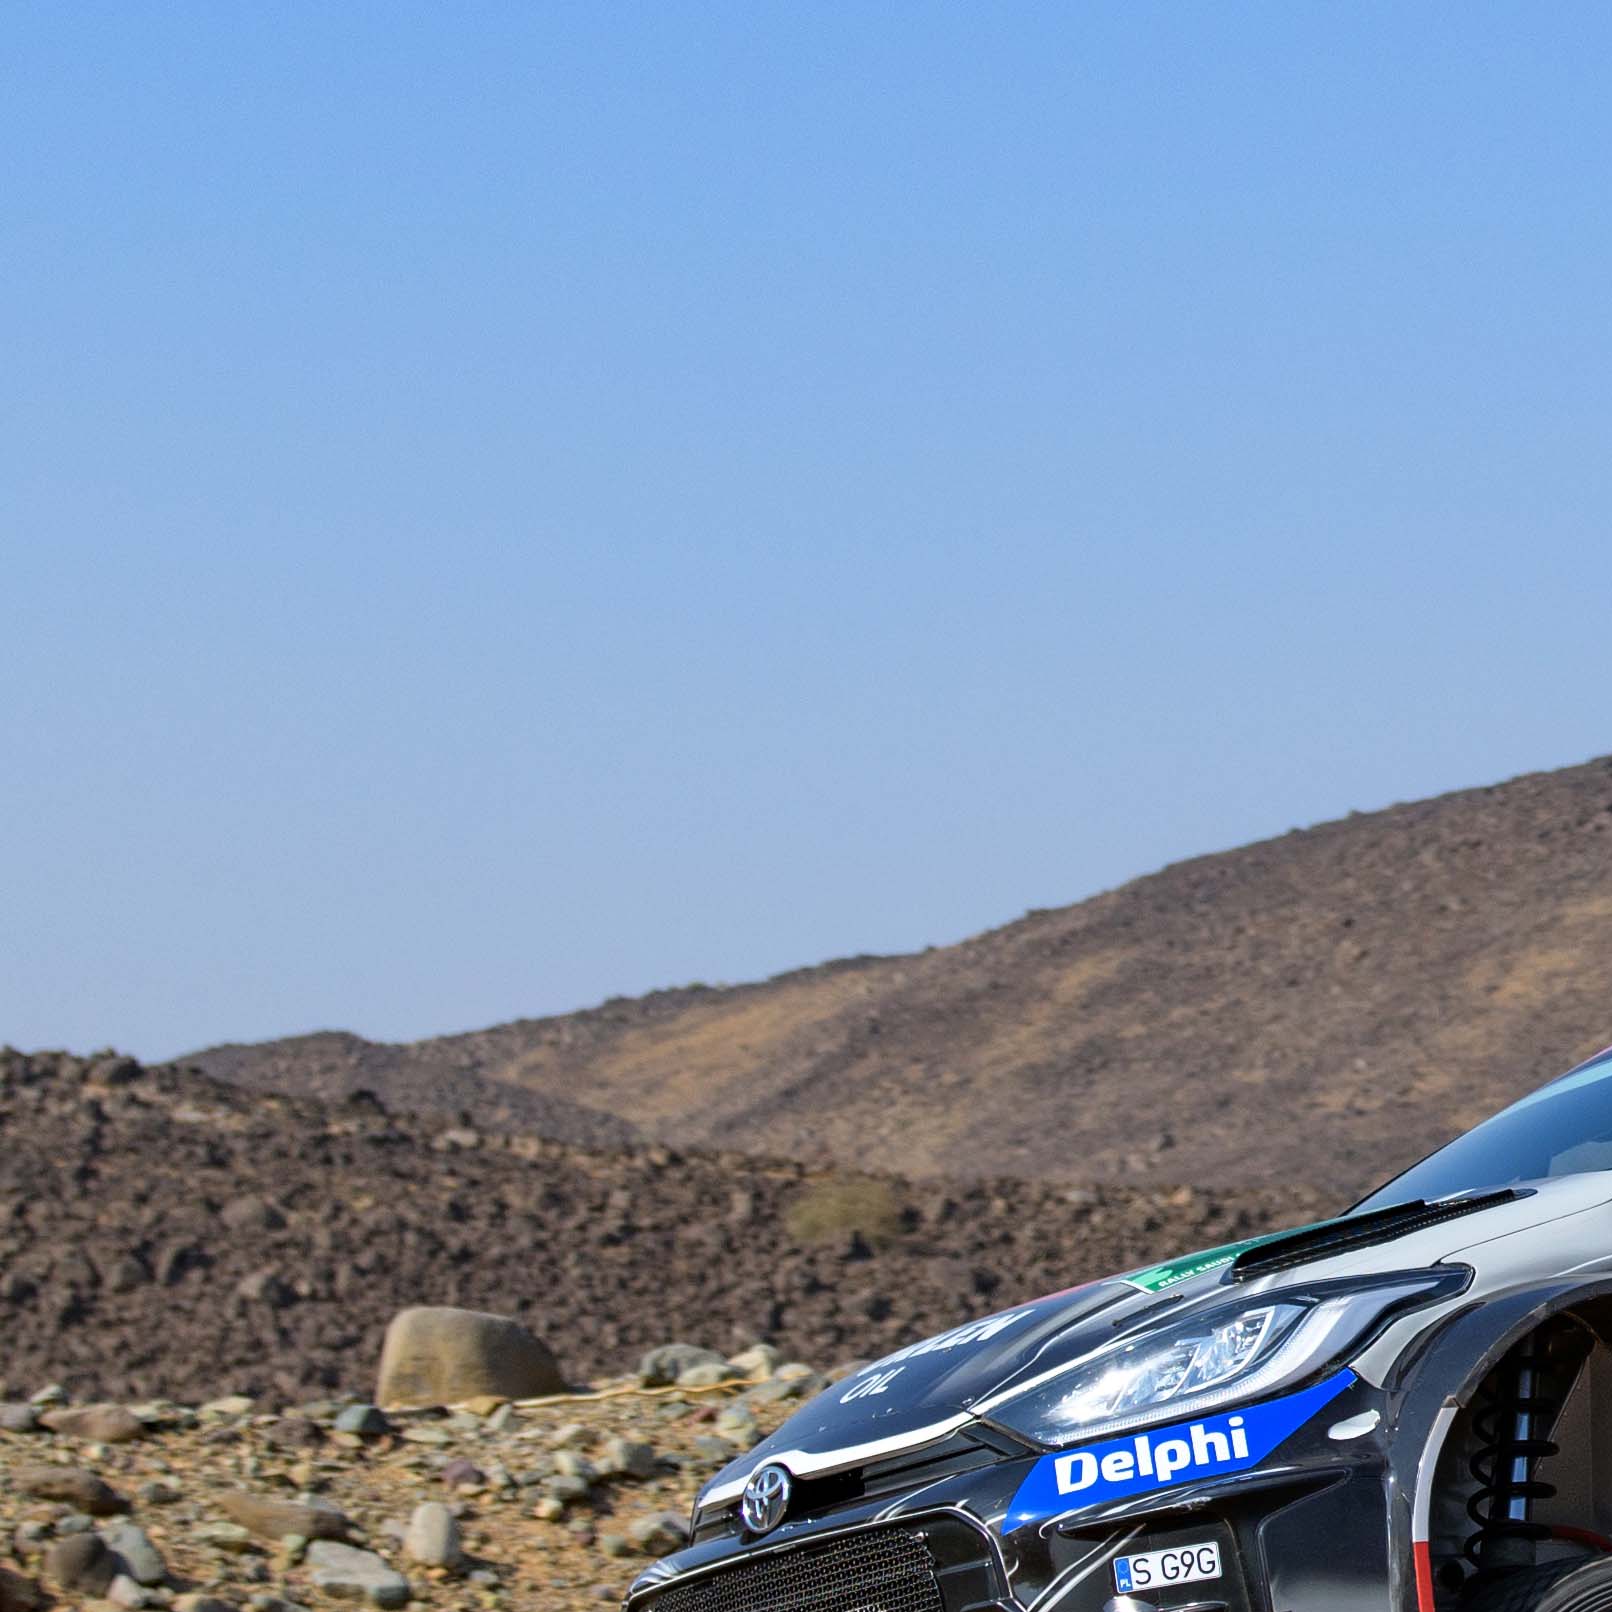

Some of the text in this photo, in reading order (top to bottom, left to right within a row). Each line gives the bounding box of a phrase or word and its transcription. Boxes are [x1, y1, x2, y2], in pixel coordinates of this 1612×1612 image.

[1158, 1270, 1195, 1288] RALLY
[839, 1366, 906, 1404] OIL
[1054, 1415, 1249, 1495] Delphi
[1132, 1557, 1152, 1585] S
[1161, 1547, 1216, 1580] G9G
